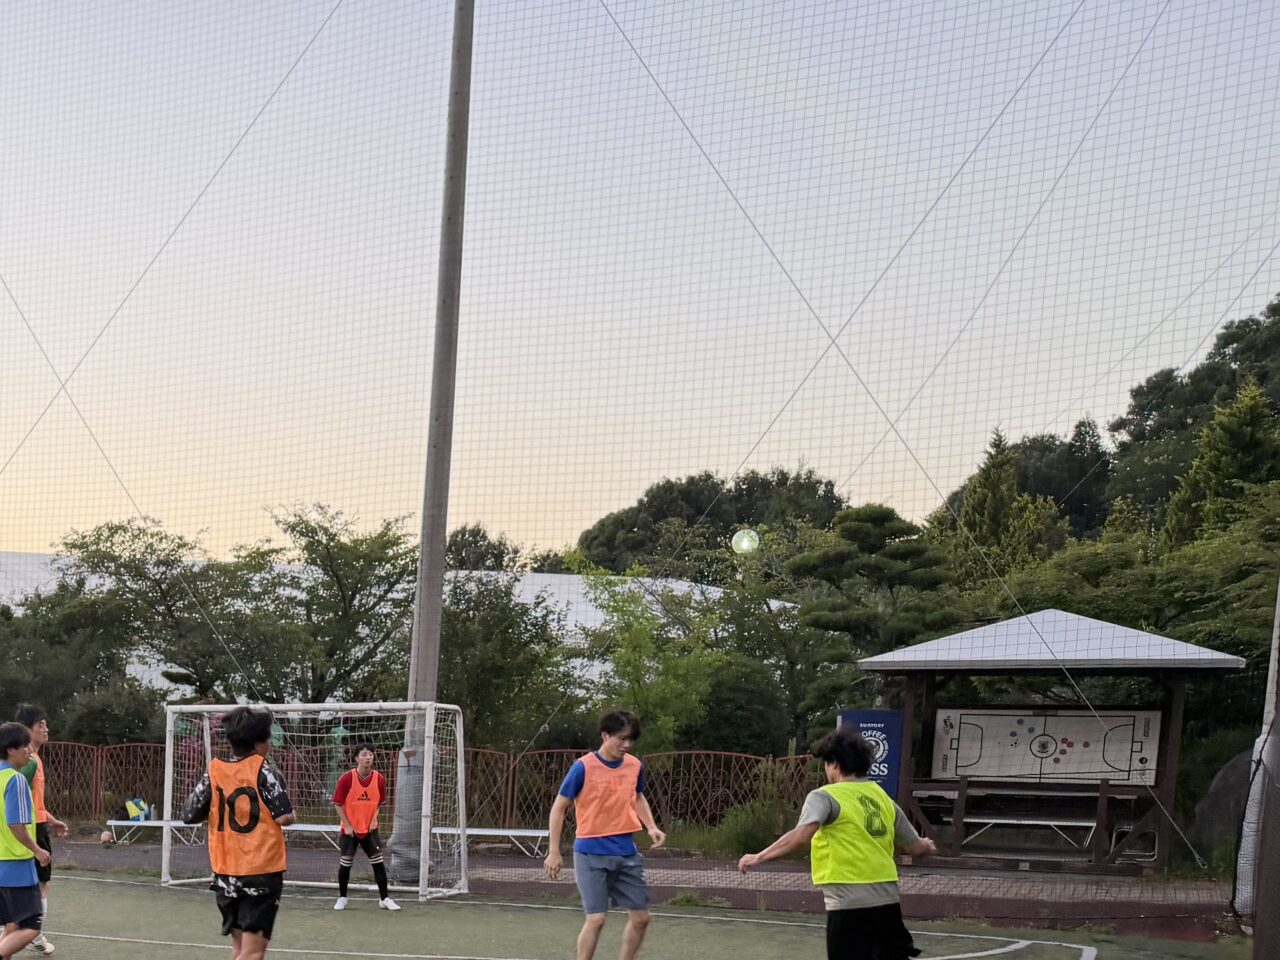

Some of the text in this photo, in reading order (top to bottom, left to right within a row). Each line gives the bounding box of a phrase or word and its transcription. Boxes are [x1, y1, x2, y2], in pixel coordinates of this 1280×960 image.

[861, 730, 887, 741] OFFEE
[869, 763, 889, 776] SS
[216, 785, 261, 834] 10
[857, 794, 888, 837] 8
